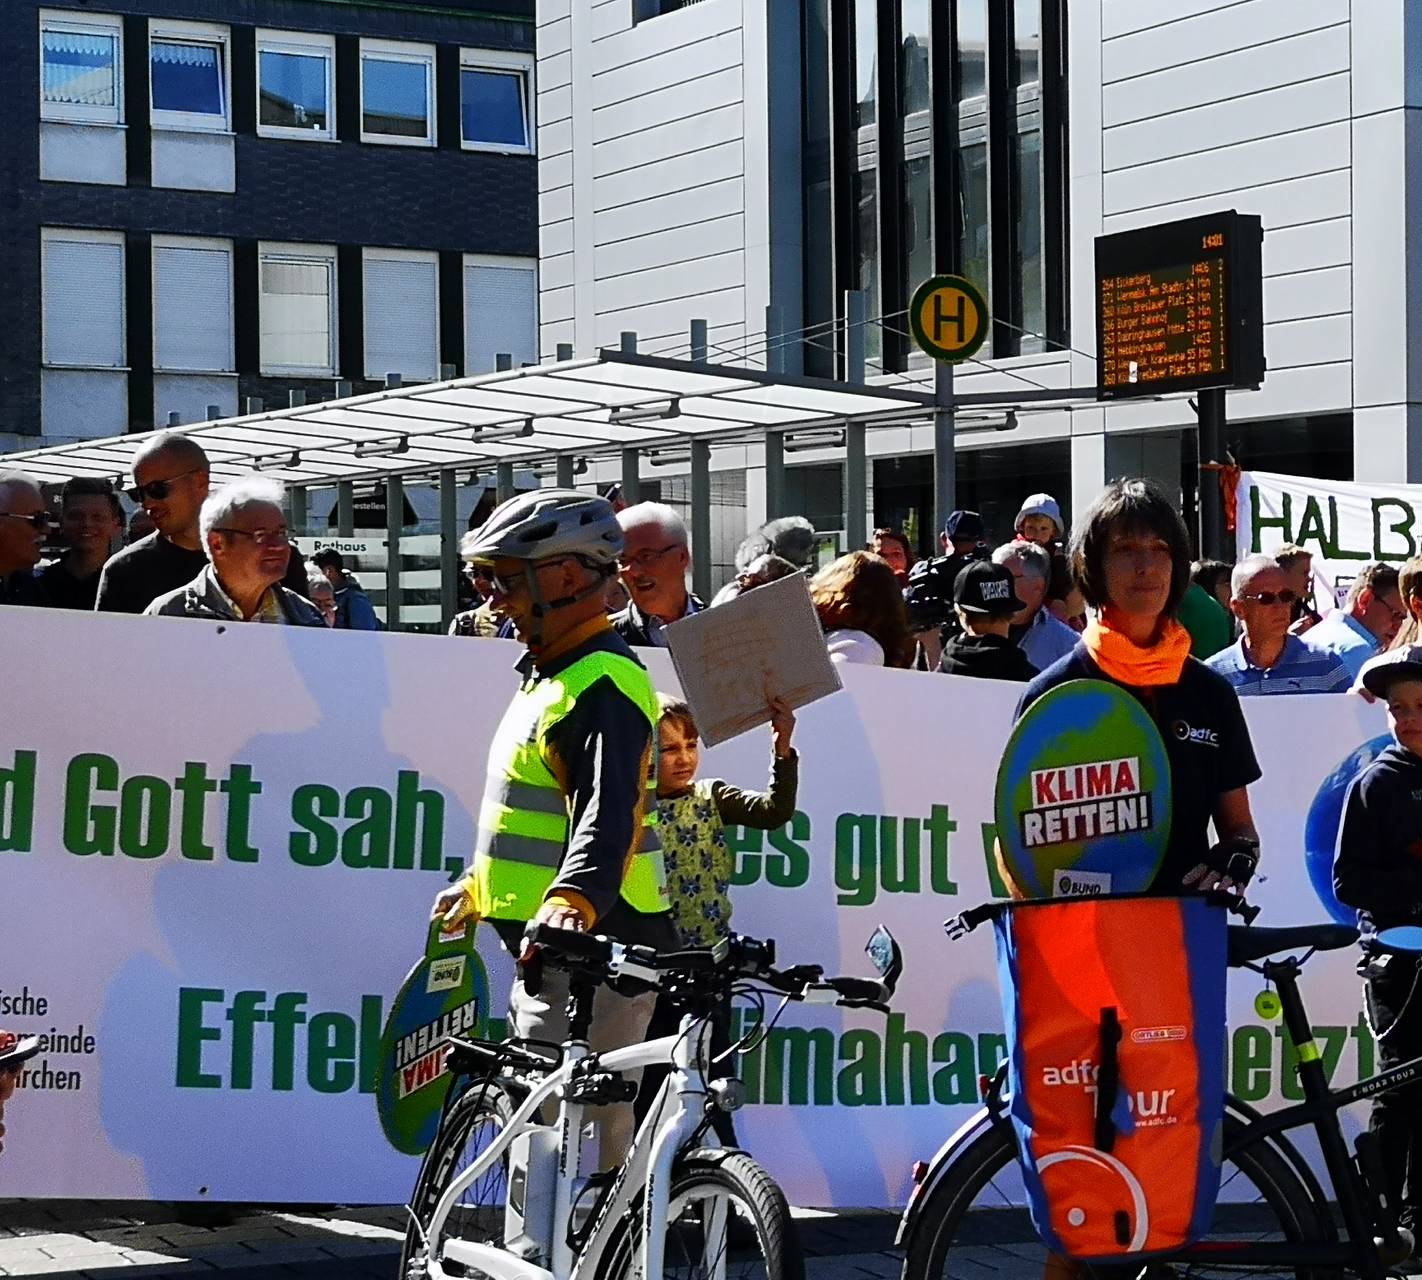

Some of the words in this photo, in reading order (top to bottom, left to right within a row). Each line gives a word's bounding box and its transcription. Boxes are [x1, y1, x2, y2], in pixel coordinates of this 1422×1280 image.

[934, 294, 966, 343] H
[353, 502, 386, 510] estellen
[1249, 484, 1416, 562] HALB
[314, 540, 367, 552] Rathaus
[1190, 727, 1219, 742] adfc
[1035, 761, 1136, 805] KLIMA
[63, 752, 262, 864] Gott
[288, 769, 464, 883] sah,
[834, 804, 958, 907] gut
[1024, 796, 1149, 847] RETTEN!
[1072, 881, 1102, 895] BUND
[396, 1000, 476, 1068] RETTEN!
[1227, 1011, 1376, 1101] etzt
